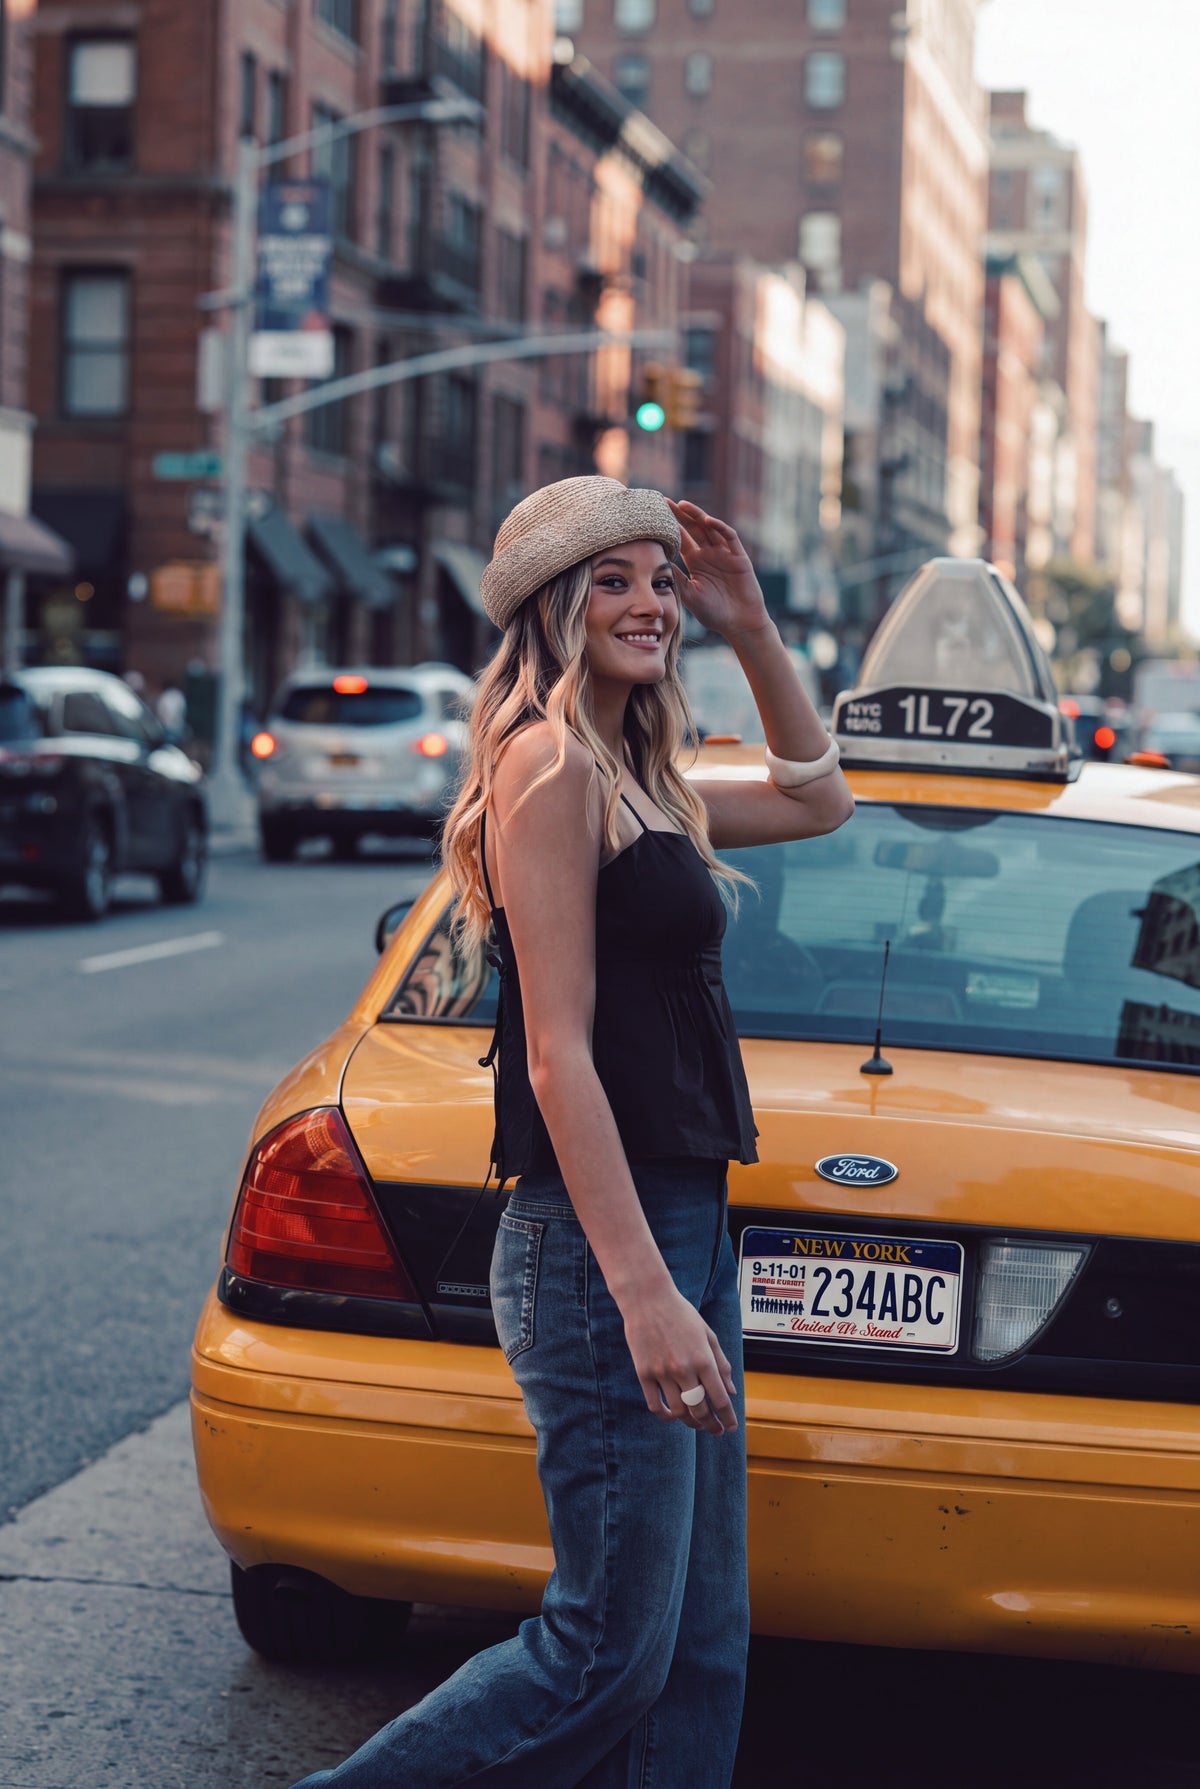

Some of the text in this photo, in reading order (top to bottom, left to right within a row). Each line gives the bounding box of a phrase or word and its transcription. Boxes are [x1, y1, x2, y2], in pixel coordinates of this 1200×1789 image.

[847, 702, 882, 717] NYC
[898, 695, 994, 738] 1L72
[833, 1158, 881, 1179] Ford
[792, 1237, 912, 1264] NEW YORK
[752, 1261, 806, 1279] 9-11-01
[810, 1266, 946, 1325] 234ABC
[790, 1317, 836, 1333] United
[859, 1322, 904, 1339] Stand
